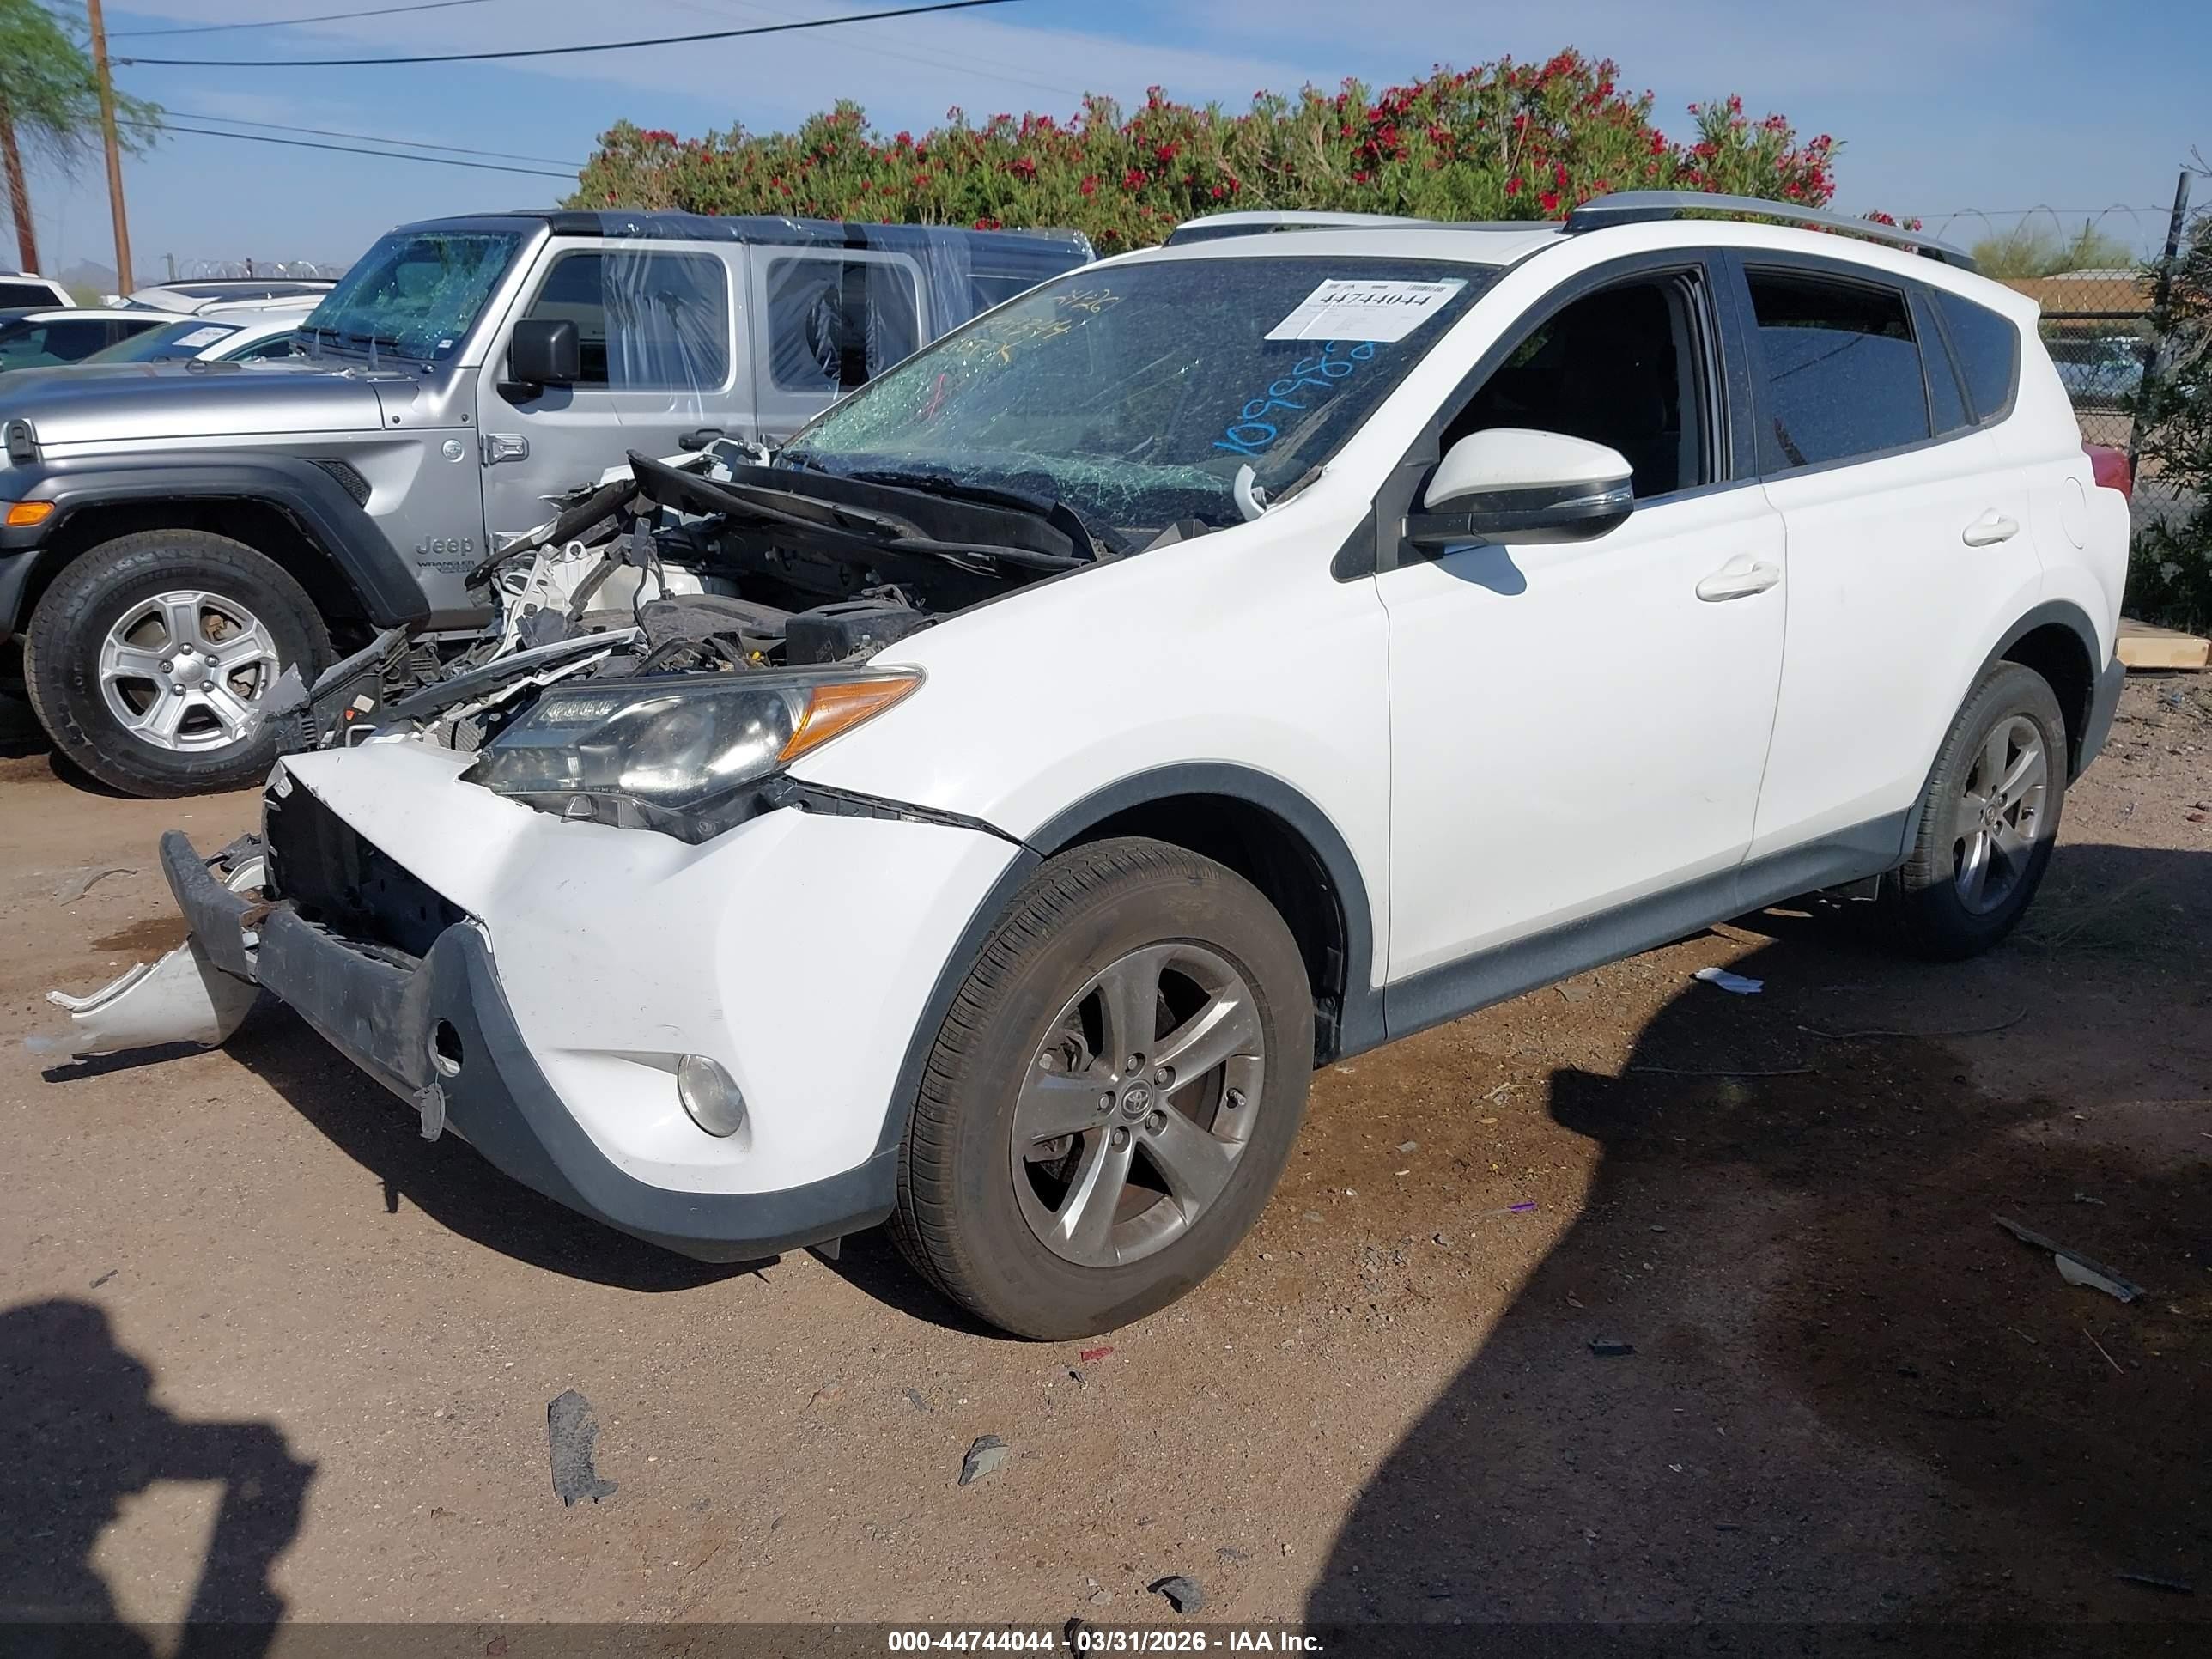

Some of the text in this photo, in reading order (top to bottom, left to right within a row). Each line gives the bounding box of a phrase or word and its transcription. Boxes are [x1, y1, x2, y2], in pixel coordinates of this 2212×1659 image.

[1321, 293, 1431, 307] 44744044
[415, 535, 475, 556] Jeep
[416, 559, 476, 568] WRANGLER
